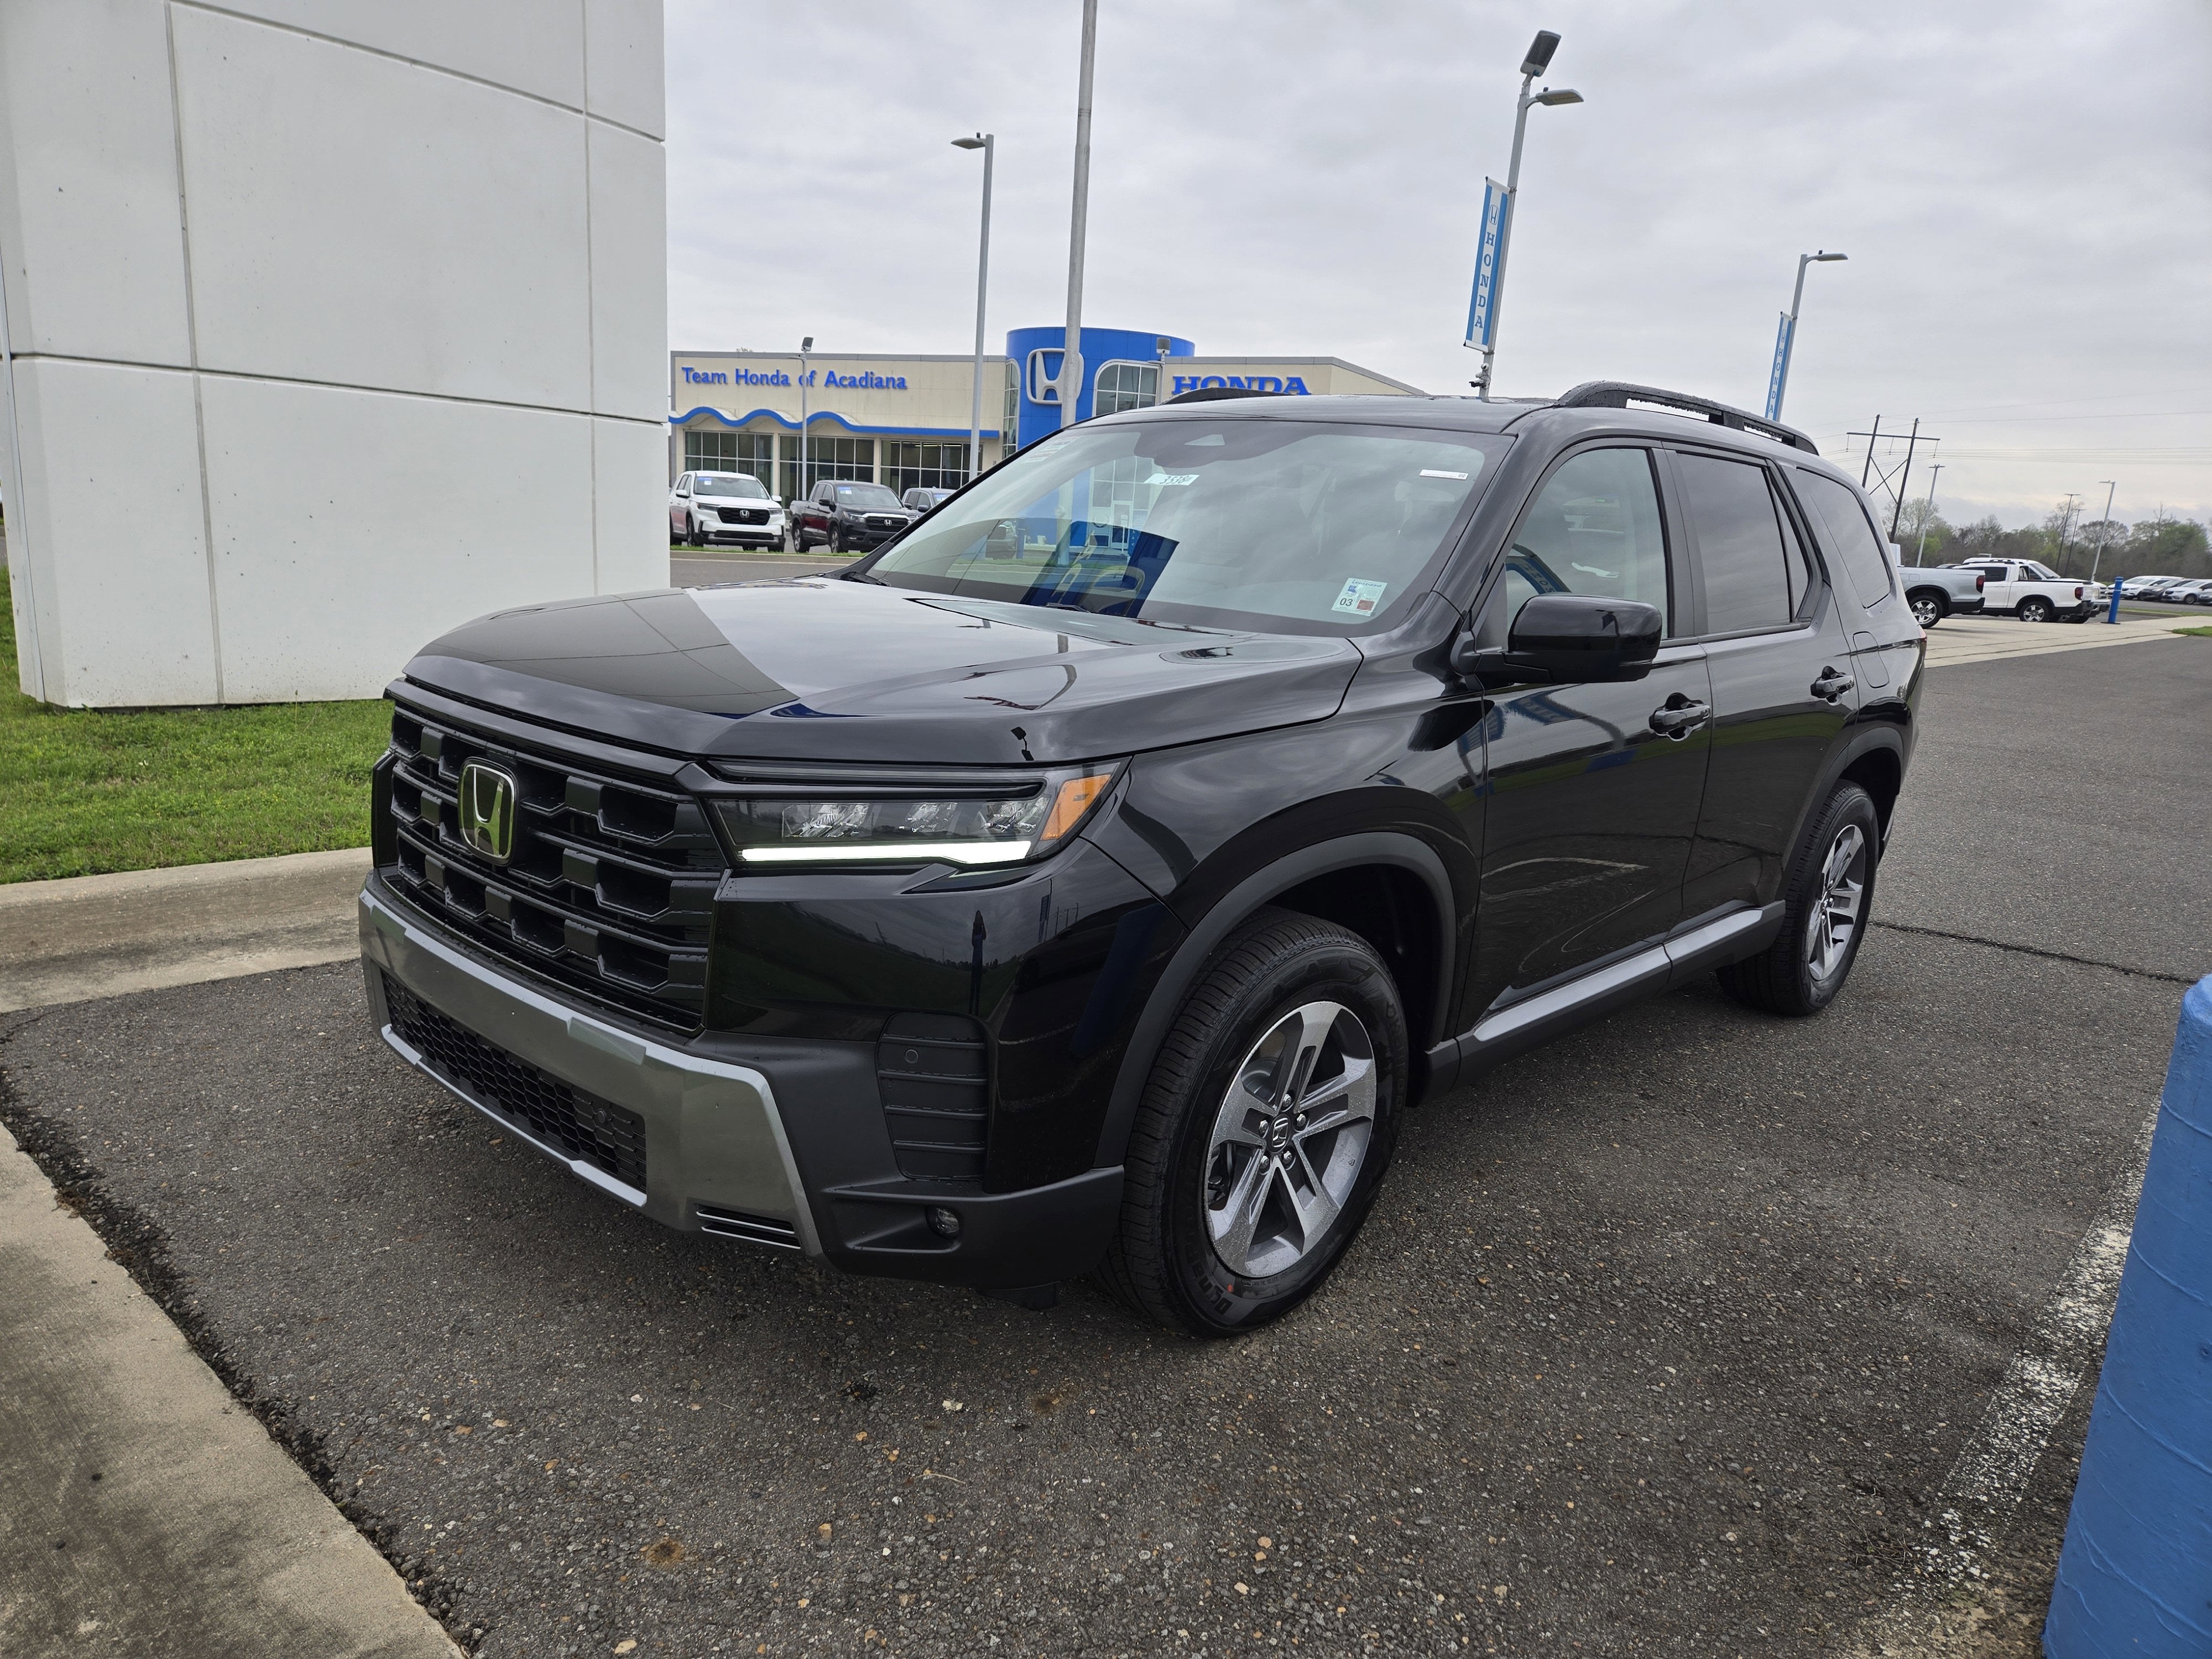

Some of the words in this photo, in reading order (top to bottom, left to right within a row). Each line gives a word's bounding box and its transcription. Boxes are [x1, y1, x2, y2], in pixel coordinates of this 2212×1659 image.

[1474, 232, 1496, 328] HONDA
[681, 367, 727, 384] Team
[735, 368, 791, 386] Honda
[799, 369, 817, 387] of
[824, 371, 908, 389] Acadiana
[1171, 375, 1312, 395] HONDA
[1769, 348, 1783, 413] HONDA
[1339, 598, 1353, 607] 03
